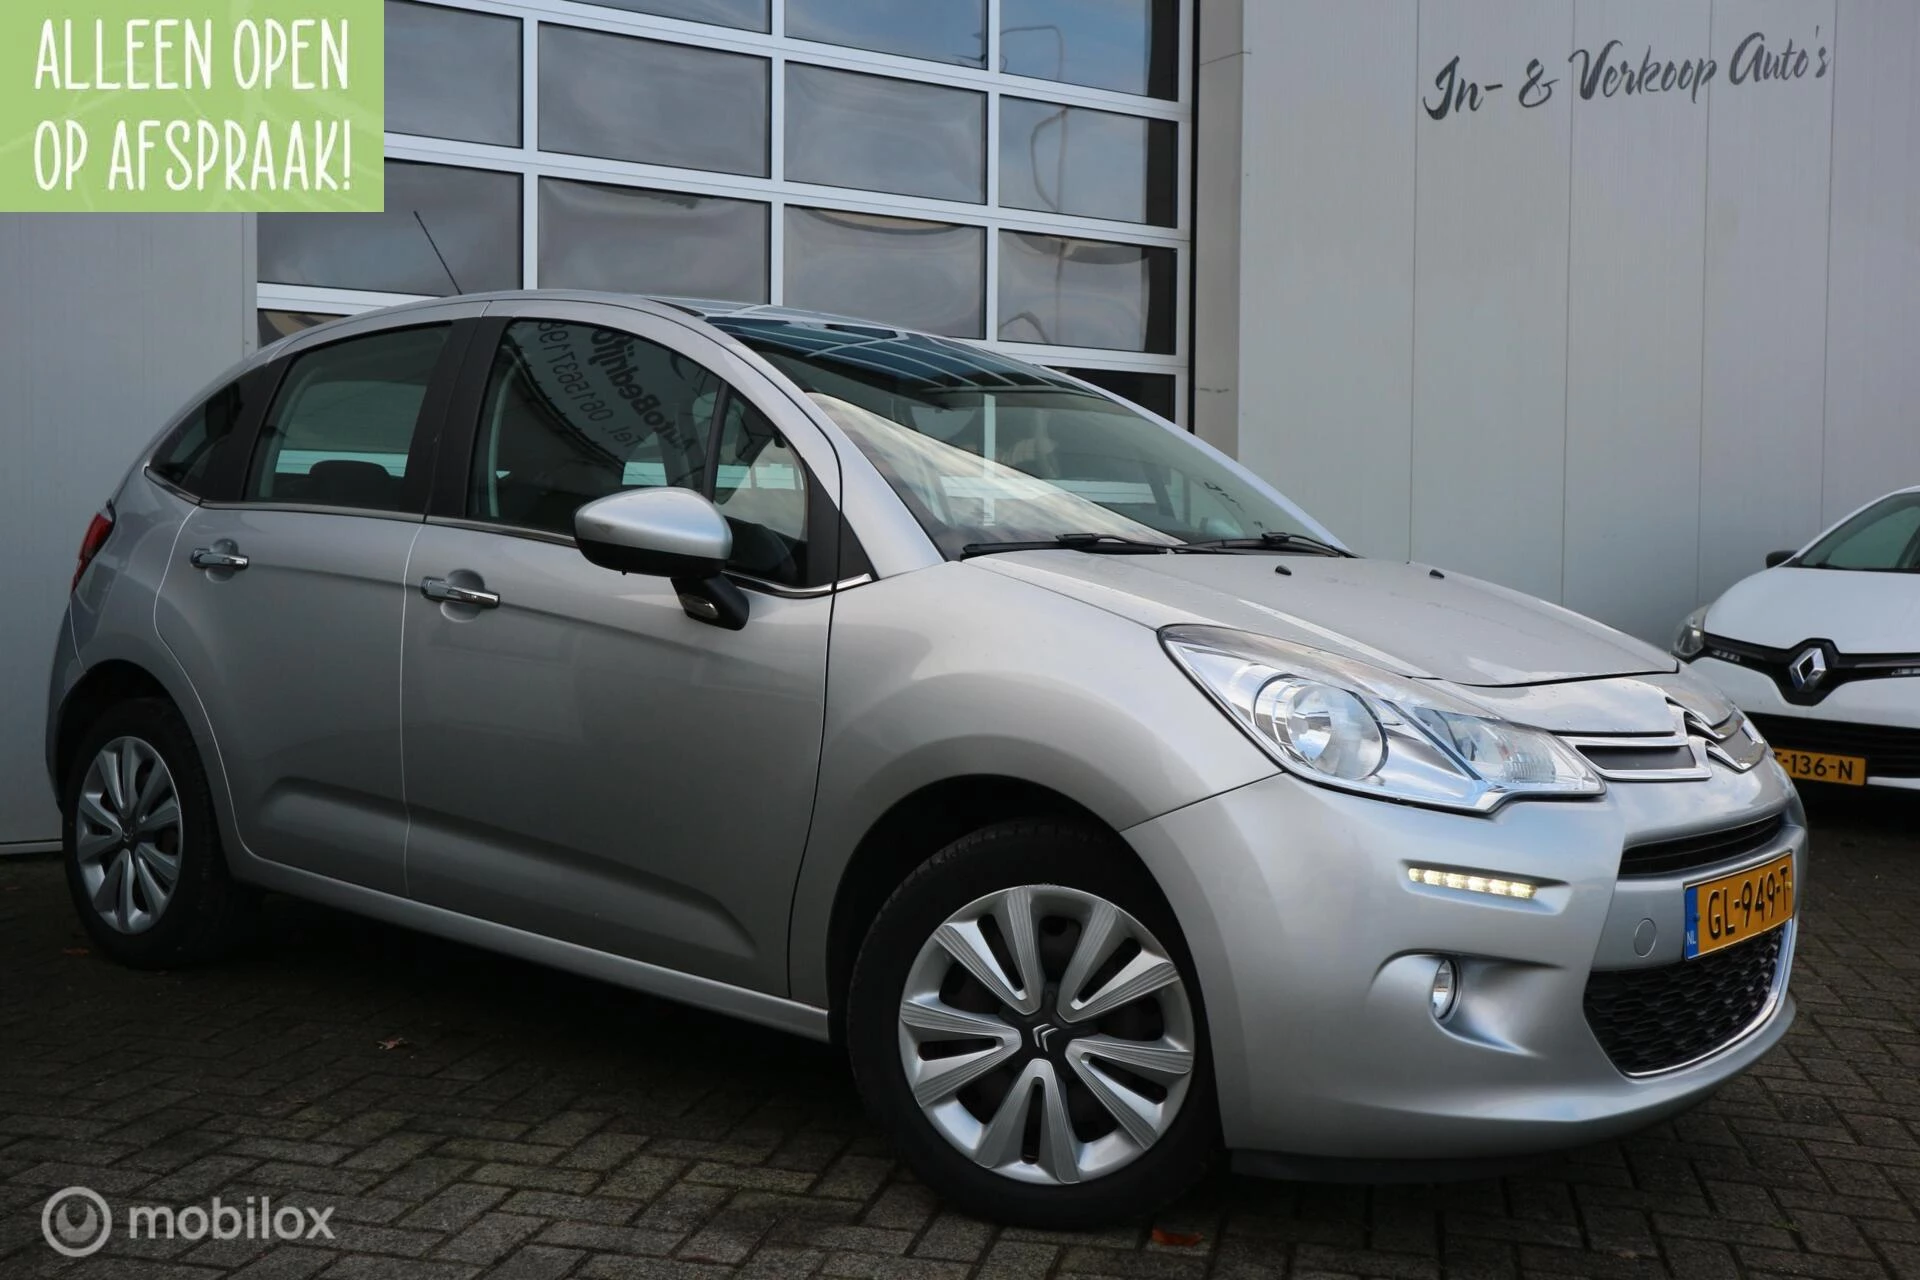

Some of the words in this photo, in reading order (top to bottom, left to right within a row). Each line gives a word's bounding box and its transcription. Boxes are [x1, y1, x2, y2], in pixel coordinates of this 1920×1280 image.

[1423, 56, 1503, 120] In-
[1519, 58, 1559, 108] &
[1568, 39, 1717, 104] Verkoop
[1686, 932, 1697, 945] NL
[1708, 865, 1788, 940] GL-949-T
